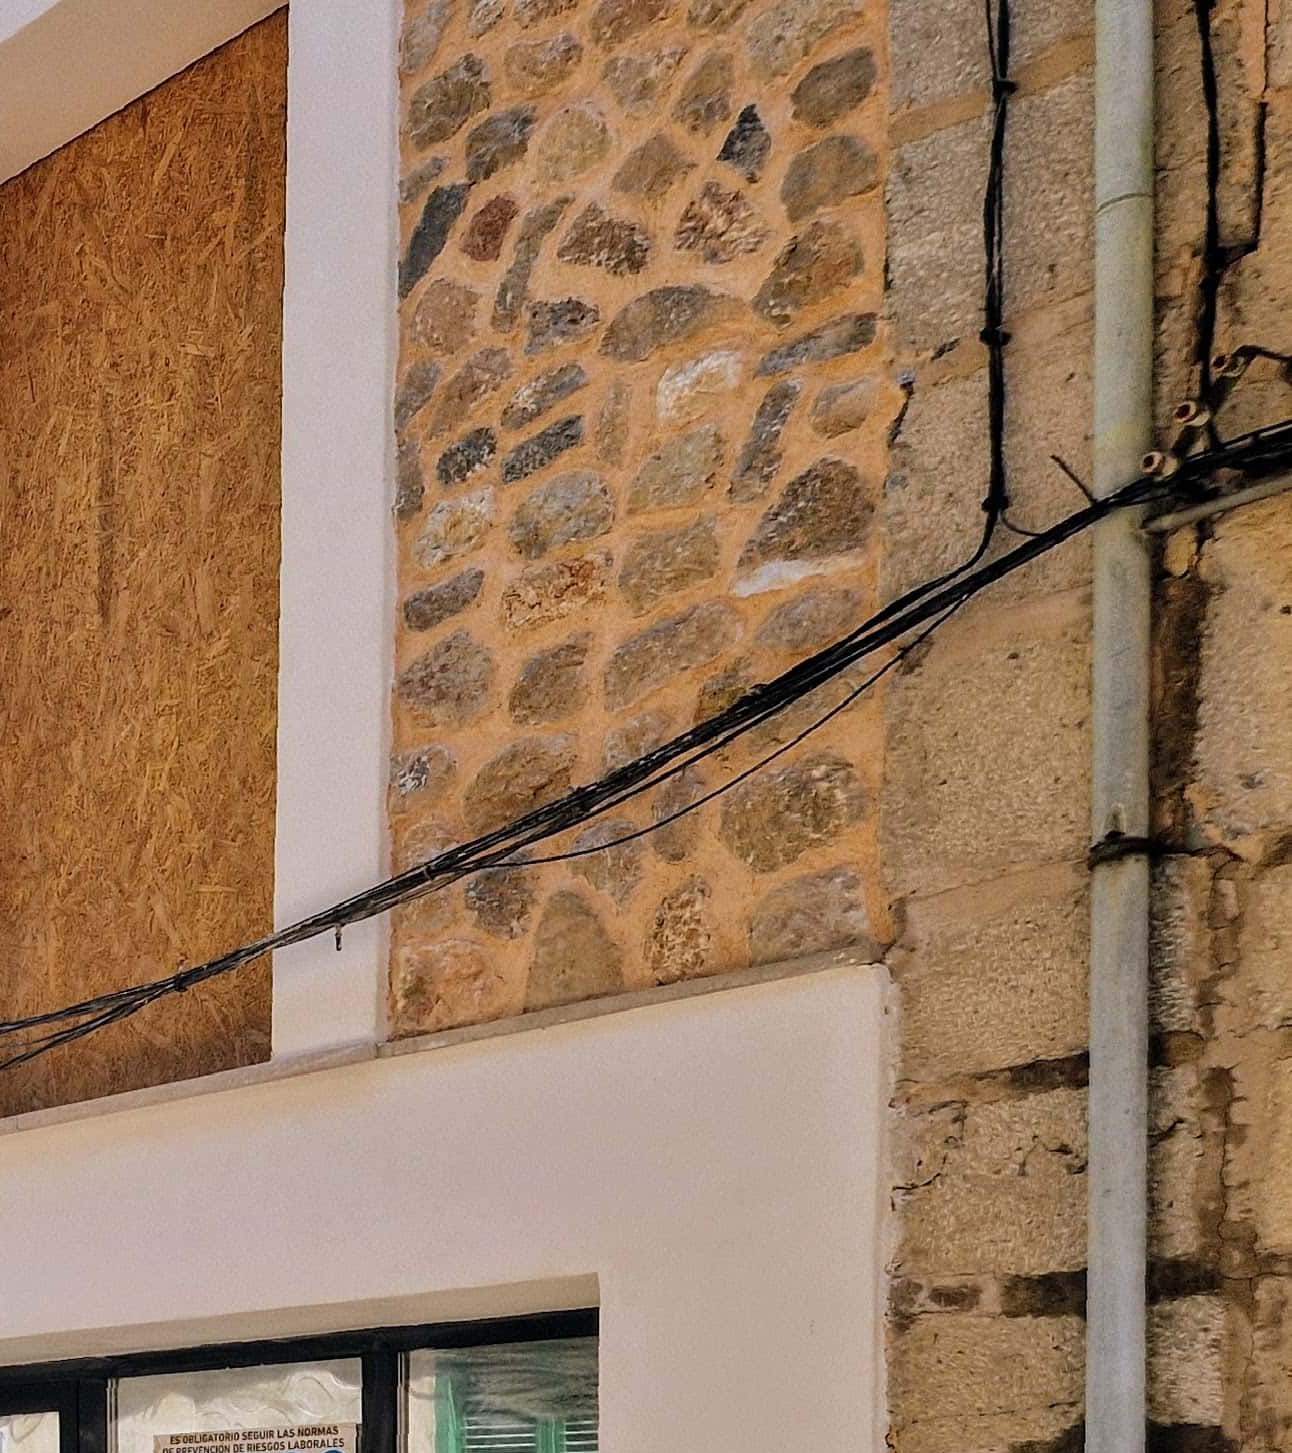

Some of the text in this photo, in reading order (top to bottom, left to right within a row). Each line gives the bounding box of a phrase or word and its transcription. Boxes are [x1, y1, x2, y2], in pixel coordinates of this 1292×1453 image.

[170, 1426, 339, 1445] ES OBLIGATORIO SEGUIR LAS NORMAS
[233, 1443, 246, 1453] DE
[247, 1441, 286, 1453] RIESGOS
[288, 1437, 345, 1450] LABORALES
